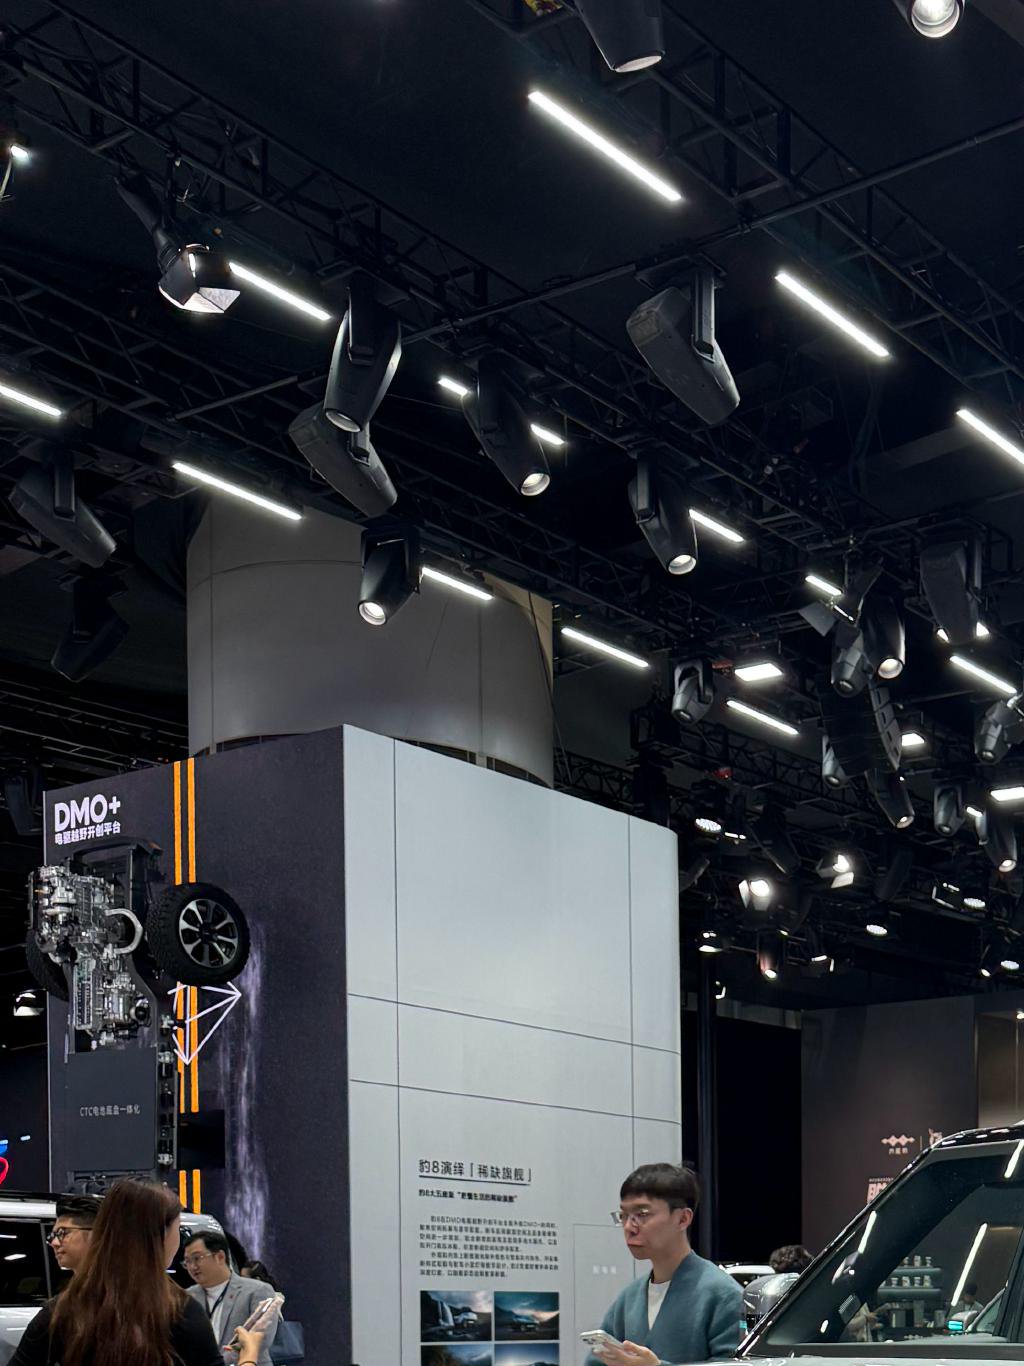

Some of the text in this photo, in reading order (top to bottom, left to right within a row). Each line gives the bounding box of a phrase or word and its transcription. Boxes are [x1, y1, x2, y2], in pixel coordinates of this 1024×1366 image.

[54, 793, 121, 833] DMO+
[54, 820, 121, 845] 电驱越野开创平台
